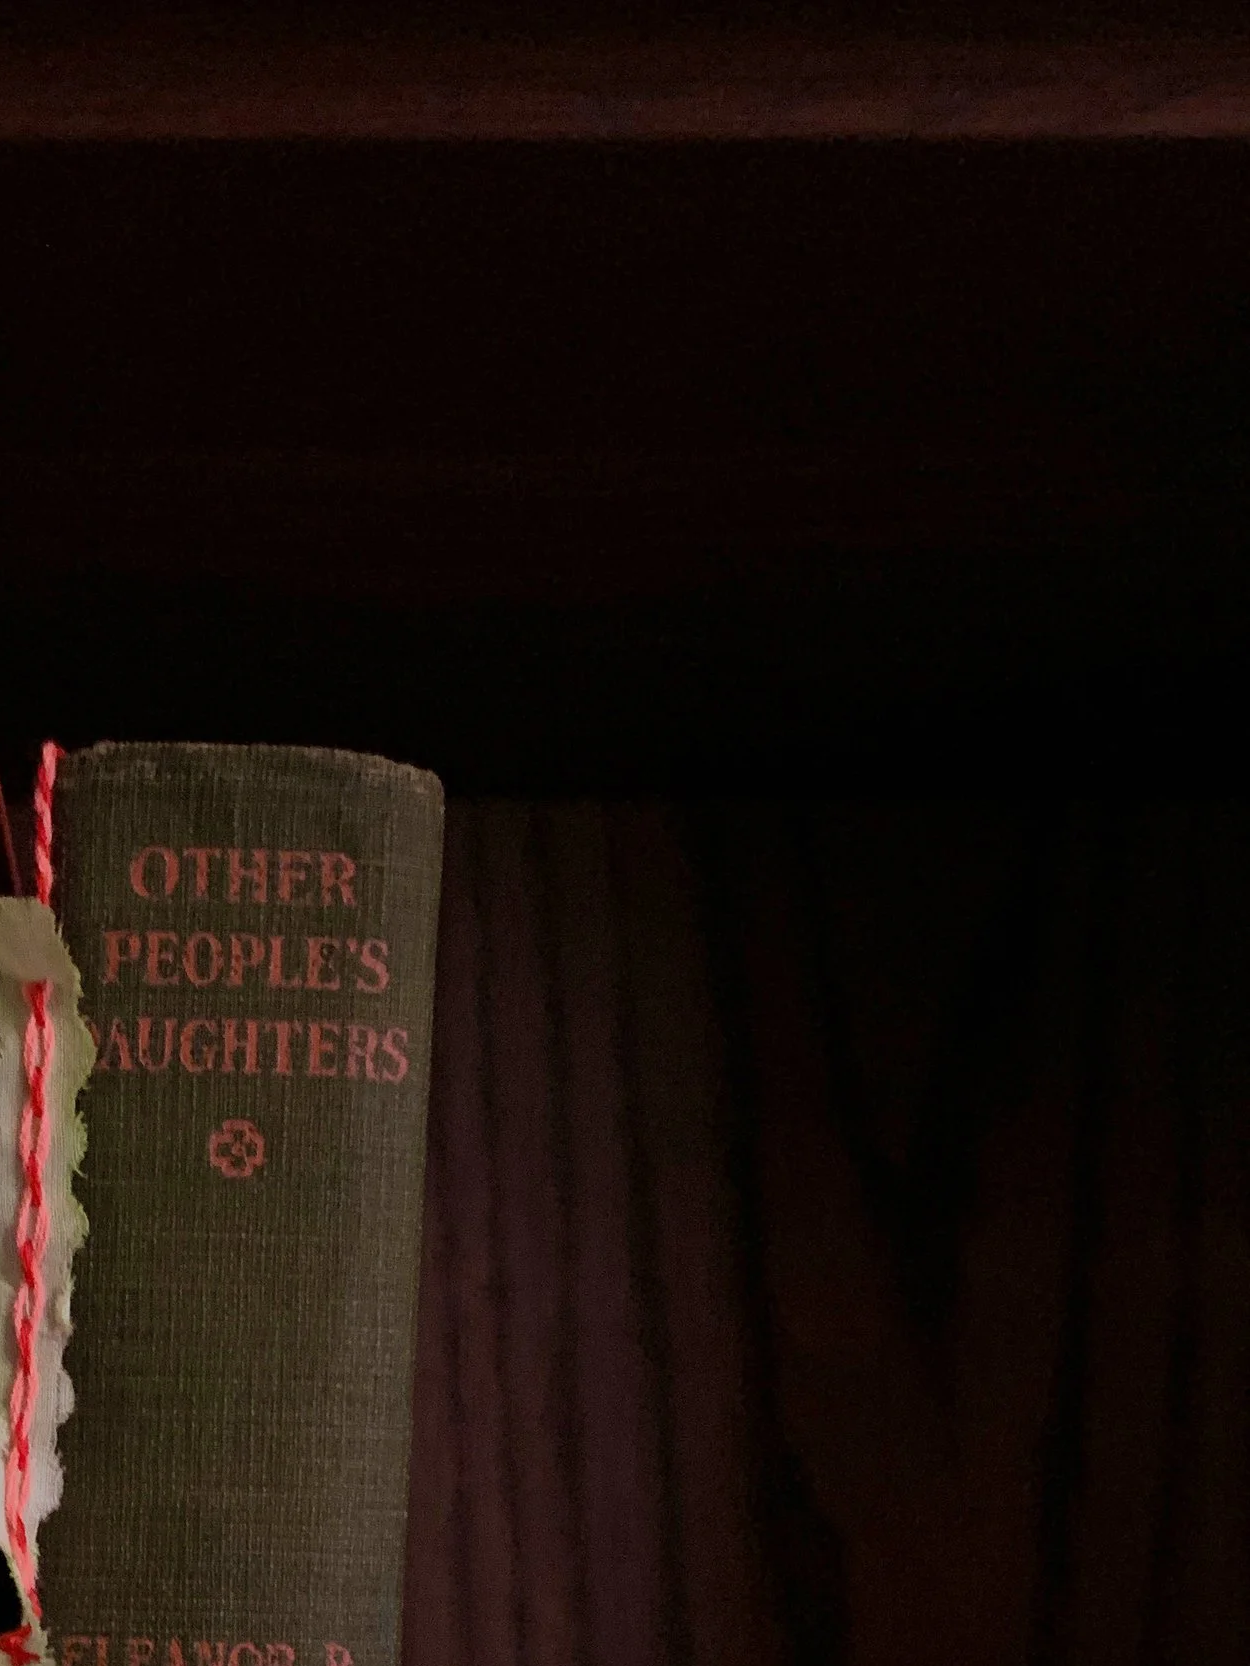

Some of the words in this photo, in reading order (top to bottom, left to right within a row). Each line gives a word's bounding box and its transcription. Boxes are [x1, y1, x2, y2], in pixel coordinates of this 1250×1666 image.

[129, 845, 357, 906] OTHER
[100, 929, 392, 994] PEOPLE'S
[86, 1014, 410, 1084] AUGHTERS
